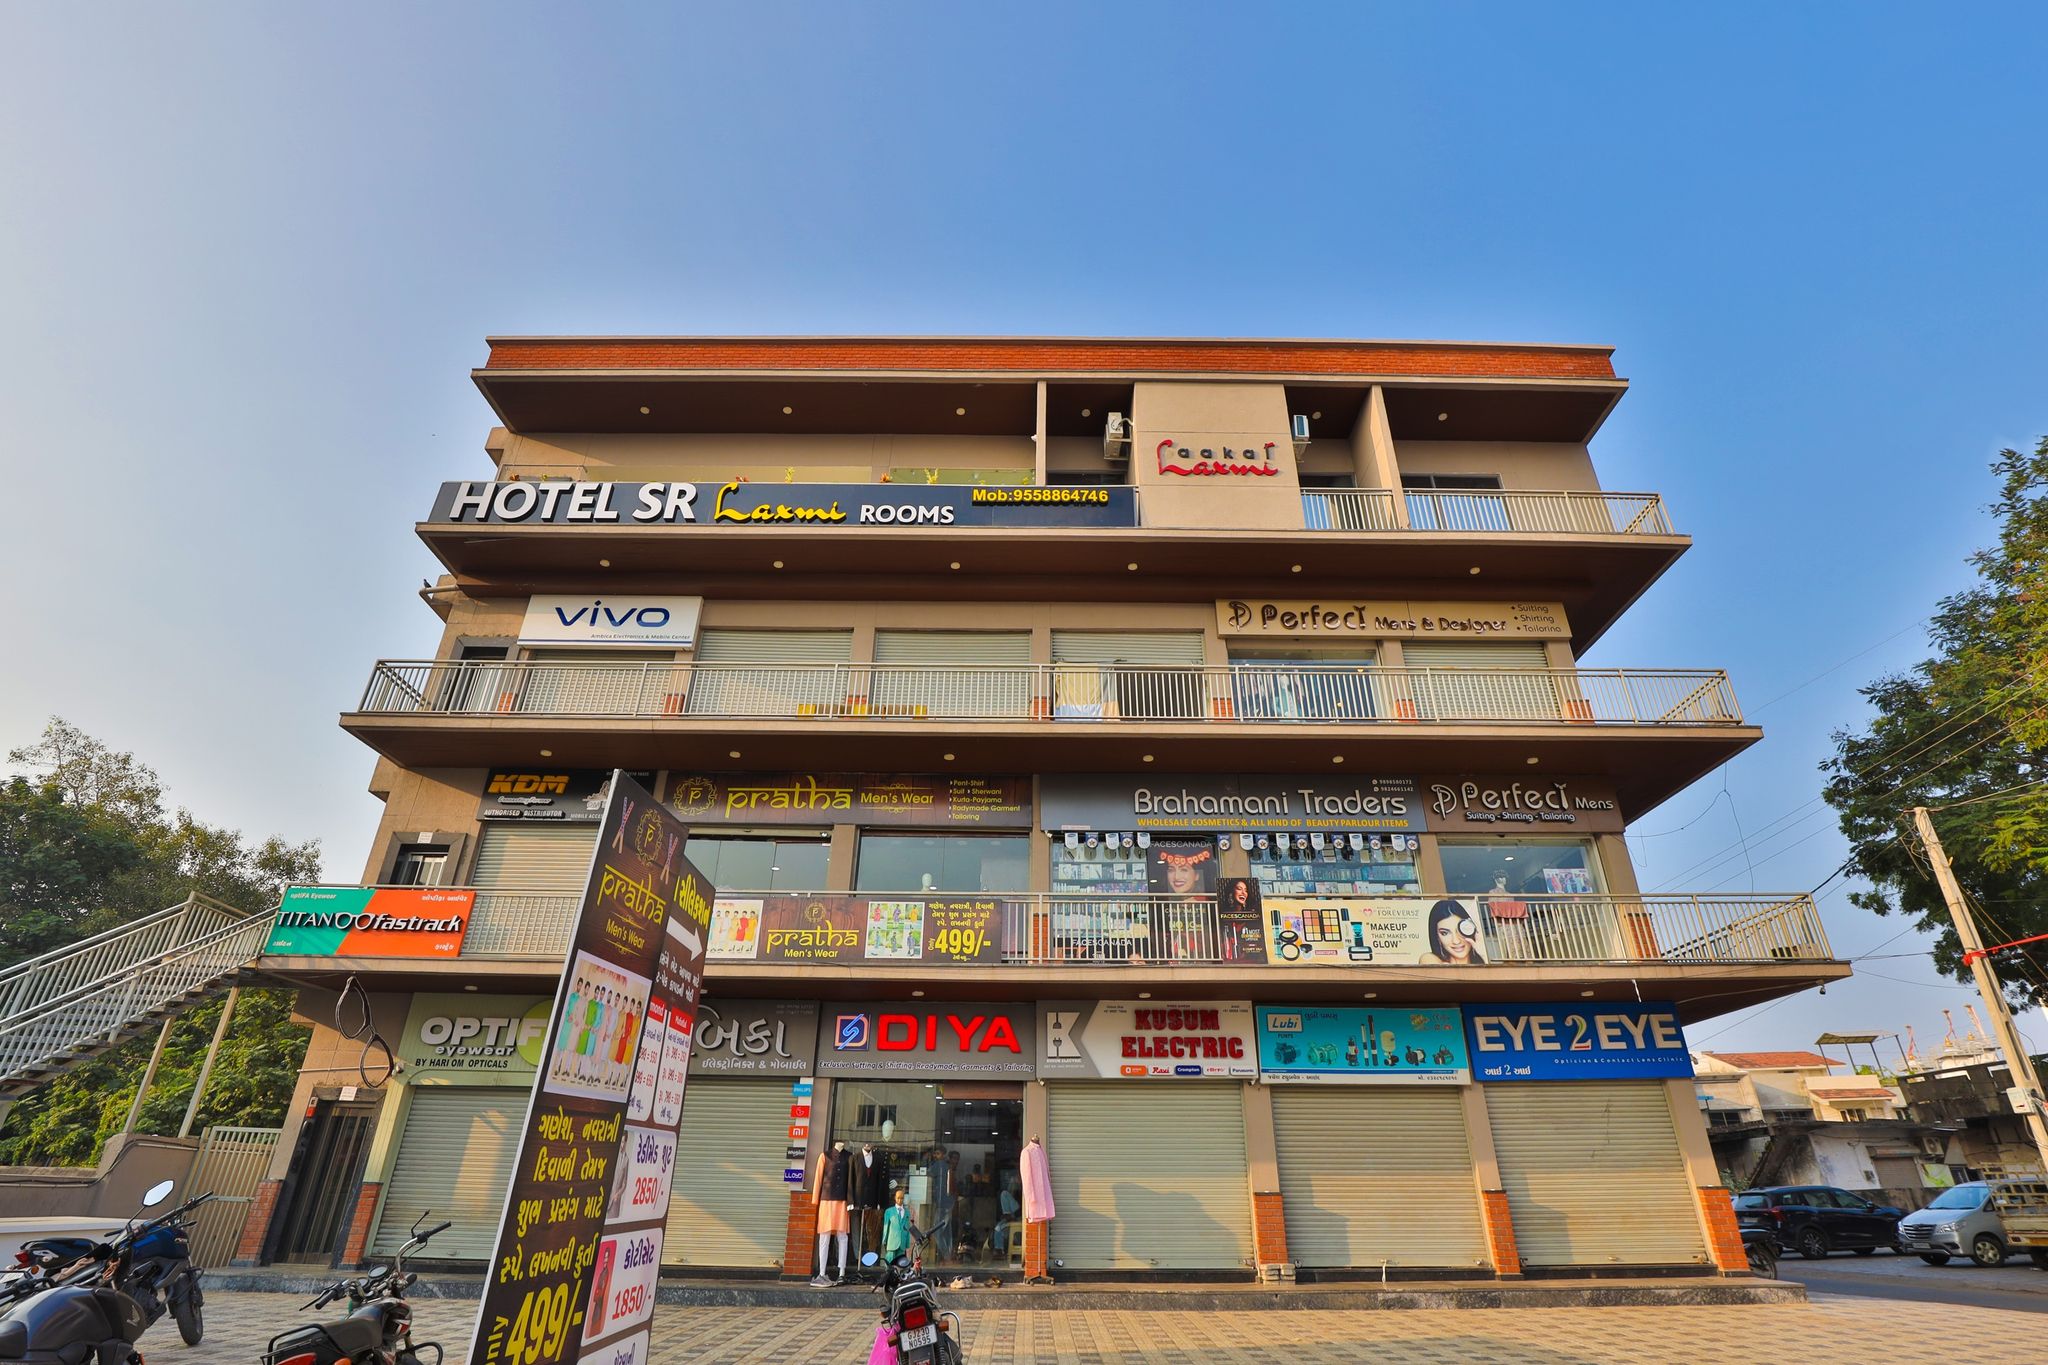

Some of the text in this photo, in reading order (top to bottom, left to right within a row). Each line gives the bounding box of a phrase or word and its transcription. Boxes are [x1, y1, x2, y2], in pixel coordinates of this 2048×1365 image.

[449, 482, 954, 523] HOTEL SR Laxmi ROOMS
[973, 488, 1109, 503] Mob:9558864746
[555, 600, 670, 627] vivo
[1261, 604, 1506, 634] Perfect Mens & Designer
[1518, 604, 1549, 613] Suiting
[1520, 614, 1555, 624] Shirting
[488, 775, 569, 793] KDM
[1461, 781, 1614, 810] Perfect Mens
[725, 776, 854, 818] pratha
[861, 793, 934, 804] Men's Wear
[1134, 788, 1407, 815] Brahamani Traders
[484, 809, 521, 817] AUTHORISED
[952, 813, 980, 821] Tailoring
[1137, 818, 1189, 827] WHOLESALE
[1191, 818, 1240, 827] COSMETICS
[1250, 818, 1264, 827] ALL
[1267, 818, 1288, 827] KIND
[1290, 819, 1302, 827] OF
[1306, 819, 1339, 827] BEAUTY
[1341, 819, 1380, 827] PARLOUR
[1382, 819, 1409, 827] ITEMS
[1466, 811, 1576, 822] Suiting Shirting Tailoring
[597, 864, 667, 925] pratha
[278, 911, 461, 932] TITAN fastrack
[606, 918, 645, 949] Men's Wear
[767, 920, 859, 953] pratha
[934, 928, 991, 957] 499/-
[784, 948, 839, 958] Men's Wear
[1135, 1009, 1220, 1031] KUSUM
[1272, 1016, 1299, 1029] Lubi
[877, 1014, 1022, 1053] DIYA
[1474, 1015, 1562, 1052] EYE
[1564, 1014, 1592, 1051] 2
[1594, 1014, 1683, 1050] EYE
[436, 1045, 515, 1057] eyewear
[1121, 1036, 1244, 1059] ELECTRIC
[415, 1058, 508, 1068] BY HARI OM OPTICALS
[819, 1060, 849, 1069] Exclusive
[960, 1063, 994, 1071] Garments
[1003, 1063, 1034, 1073] Tailoring
[1504, 1064, 1512, 1076] 2
[538, 1105, 621, 1145] ગણેશ, નવરાત્રી
[533, 1145, 607, 1182] દિવાળી તેમજ
[632, 1178, 663, 1208] 2850/-
[517, 1186, 605, 1238] શુભ પ્રસંગ માટે
[612, 1282, 652, 1320] 1850/-
[485, 1279, 583, 1365] nly 499/-
